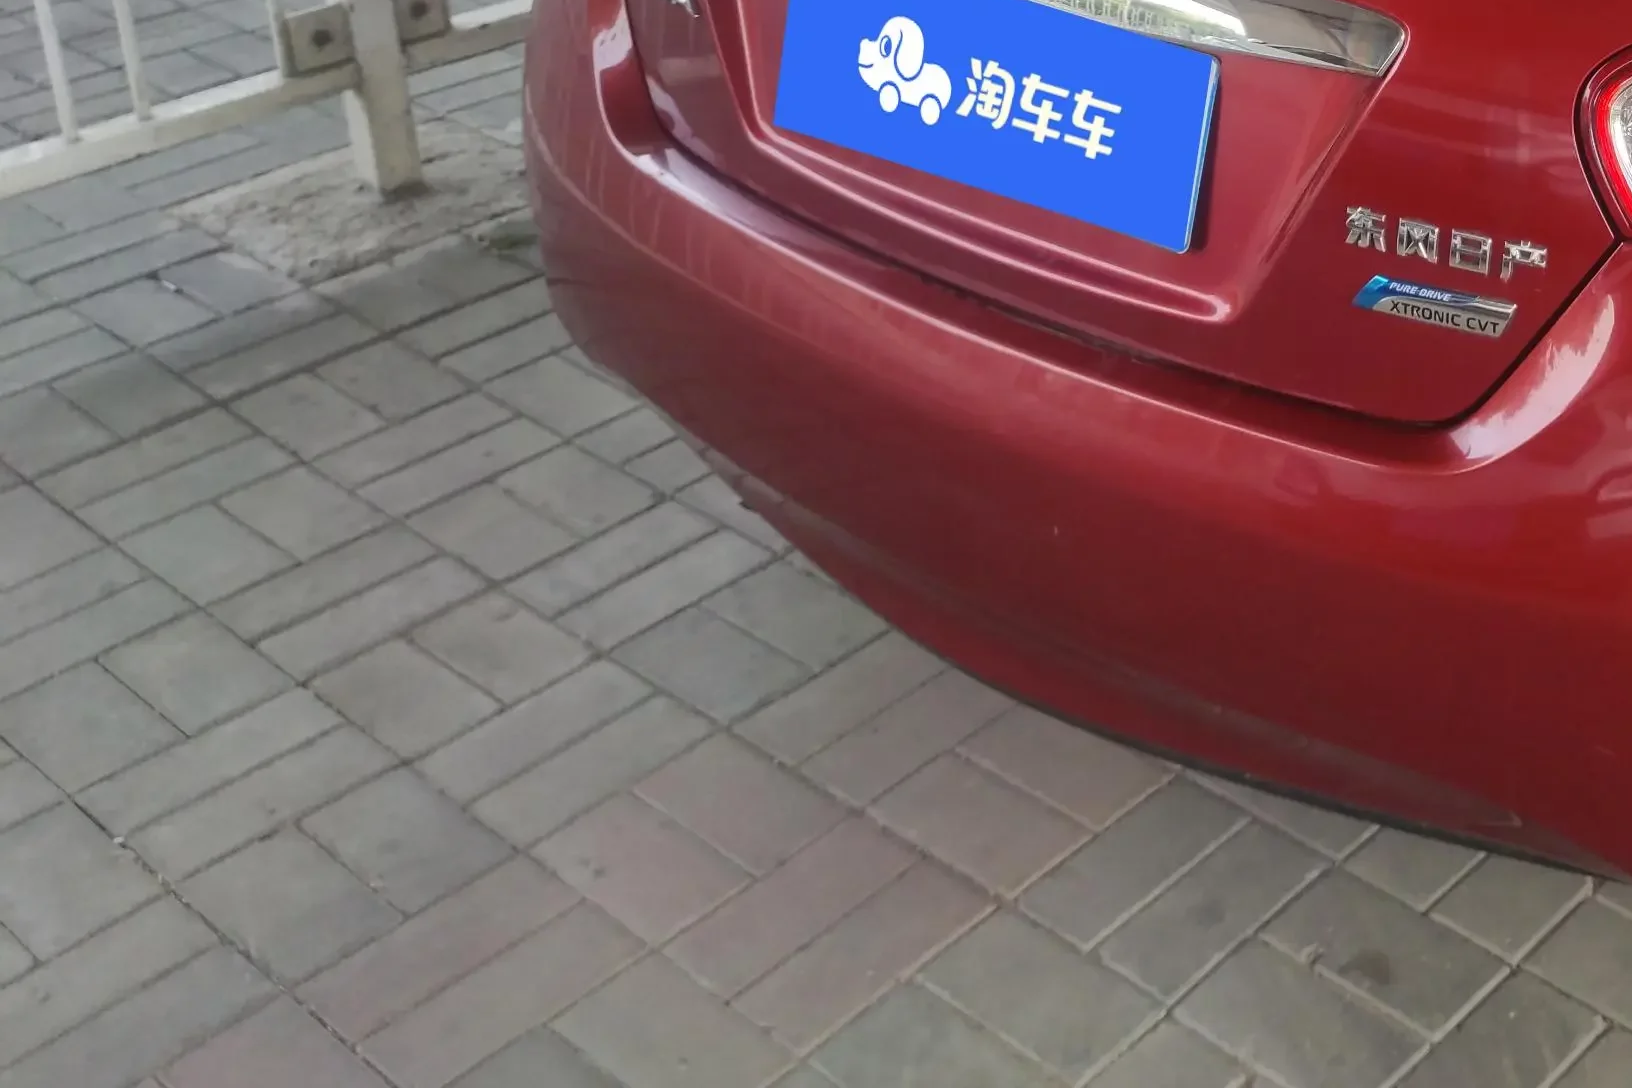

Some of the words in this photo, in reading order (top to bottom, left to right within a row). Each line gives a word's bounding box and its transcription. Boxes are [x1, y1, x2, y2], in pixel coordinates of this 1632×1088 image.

[1344, 206, 1548, 282] 东风日产
[1389, 299, 1461, 327] XTRONIC
[1465, 317, 1500, 334] CVT
